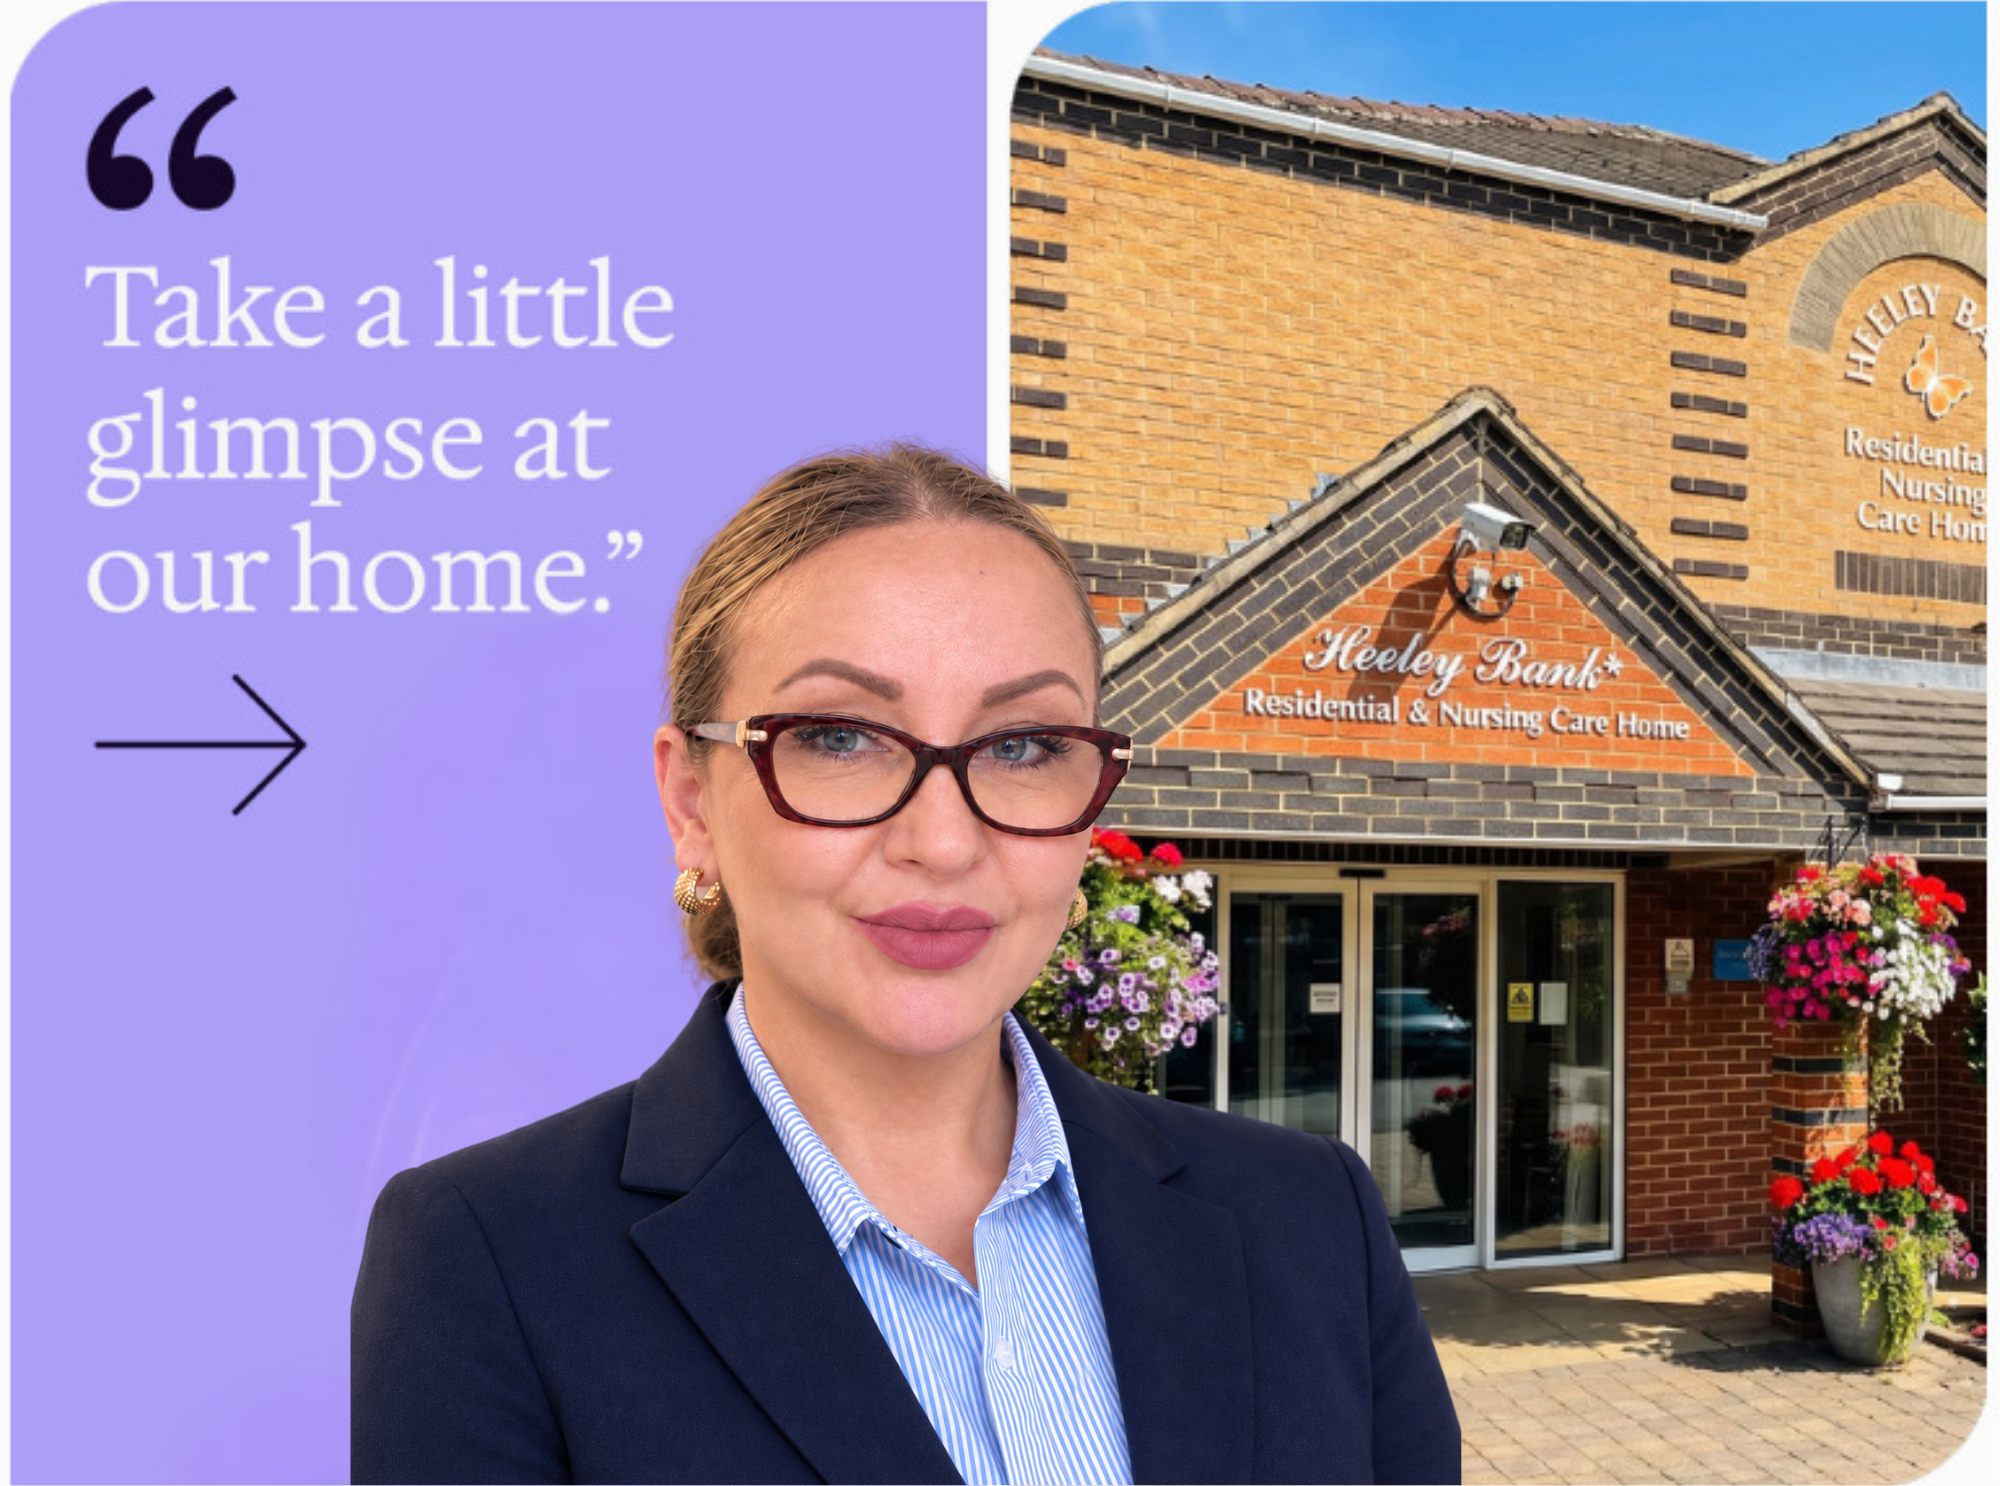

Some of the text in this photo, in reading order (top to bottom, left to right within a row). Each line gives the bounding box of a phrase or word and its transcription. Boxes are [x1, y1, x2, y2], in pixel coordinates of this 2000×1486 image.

[1845, 283, 1941, 387] HEELEY
[1845, 427, 1987, 475] Residentia
[1857, 501, 1921, 535] Care
[1881, 467, 1987, 519] Nursing
[1304, 625, 1466, 698] Heeley
[1244, 687, 1690, 739] Residential & Nursing Care Home
